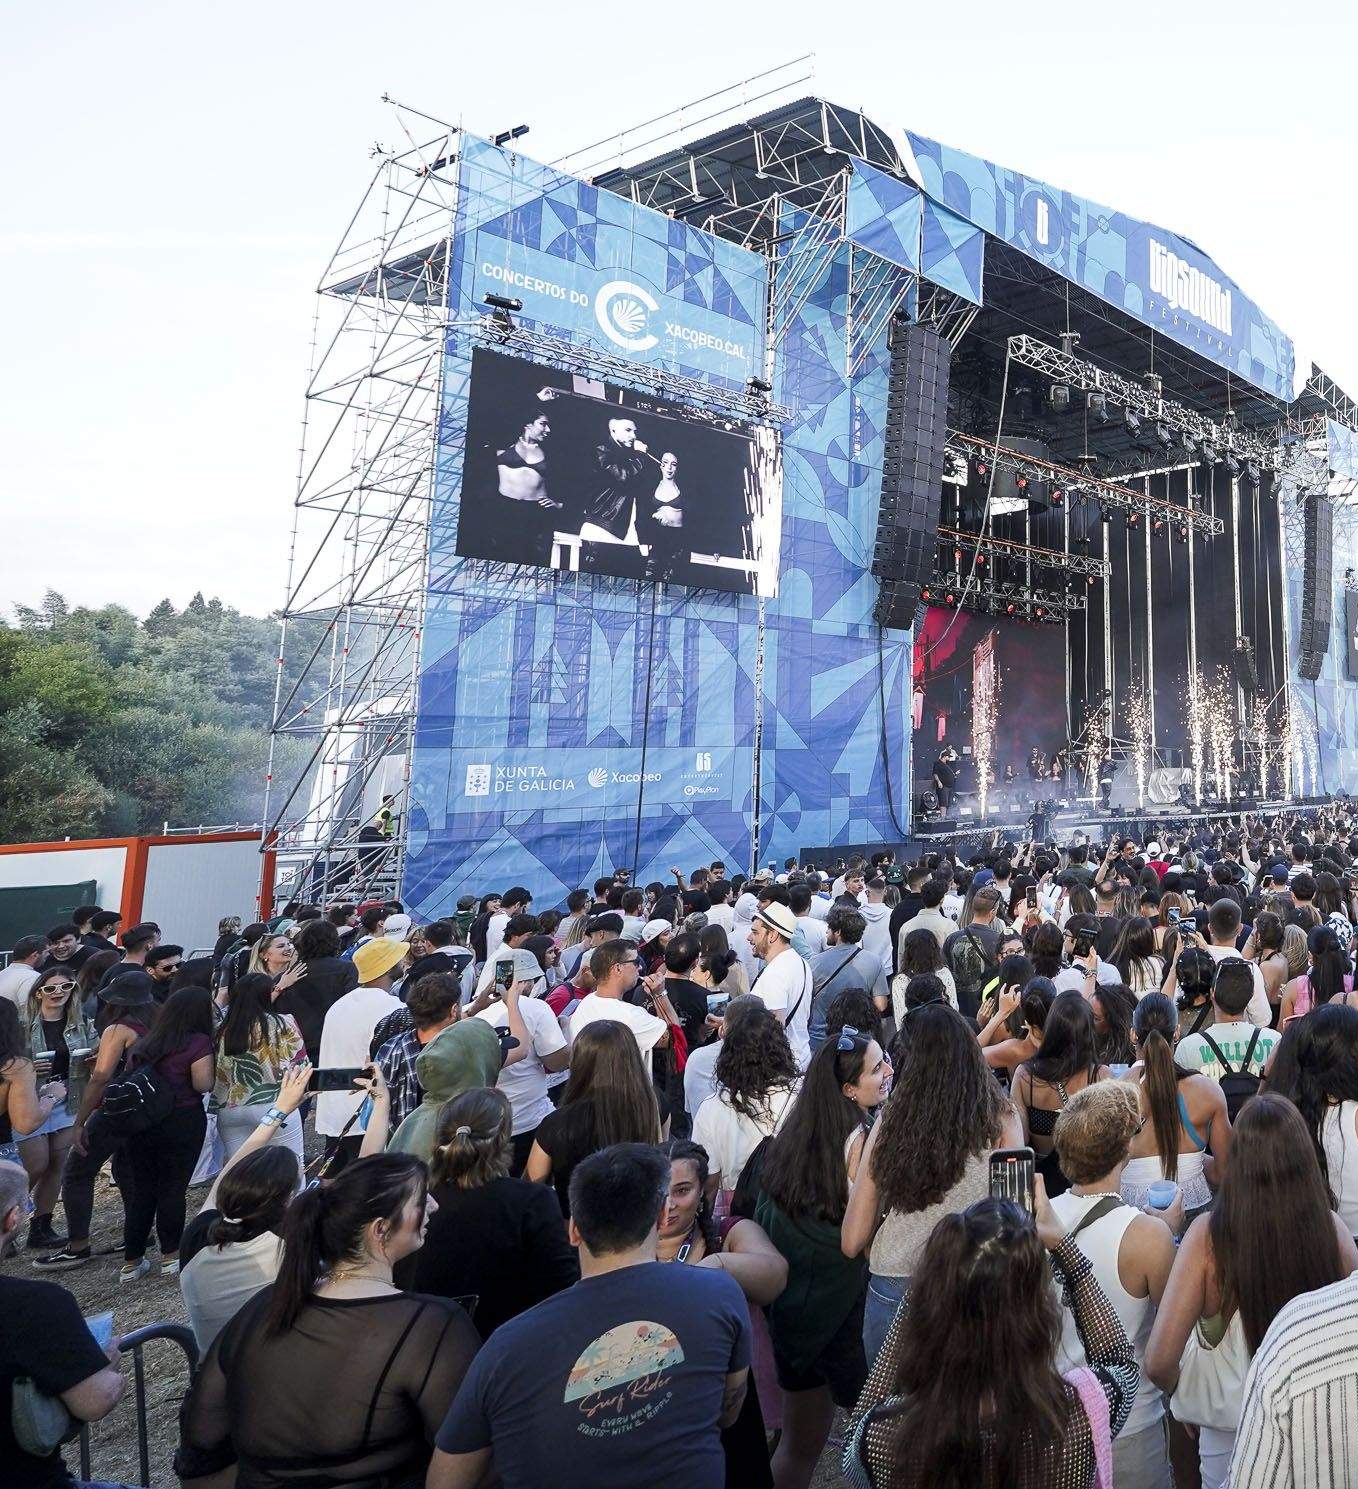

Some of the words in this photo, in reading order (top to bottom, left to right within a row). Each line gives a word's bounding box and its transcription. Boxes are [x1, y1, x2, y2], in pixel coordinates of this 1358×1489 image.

[482, 262, 566, 300] CONCERTOS
[570, 289, 589, 307] DO
[496, 766, 547, 778] XUNTA
[495, 780, 514, 792] DE
[519, 779, 575, 792] GALICIA
[578, 1390, 625, 1418] Surf
[627, 1370, 673, 1400] Rider
[601, 1415, 629, 1428] EVERY
[611, 1424, 633, 1436] WITH
